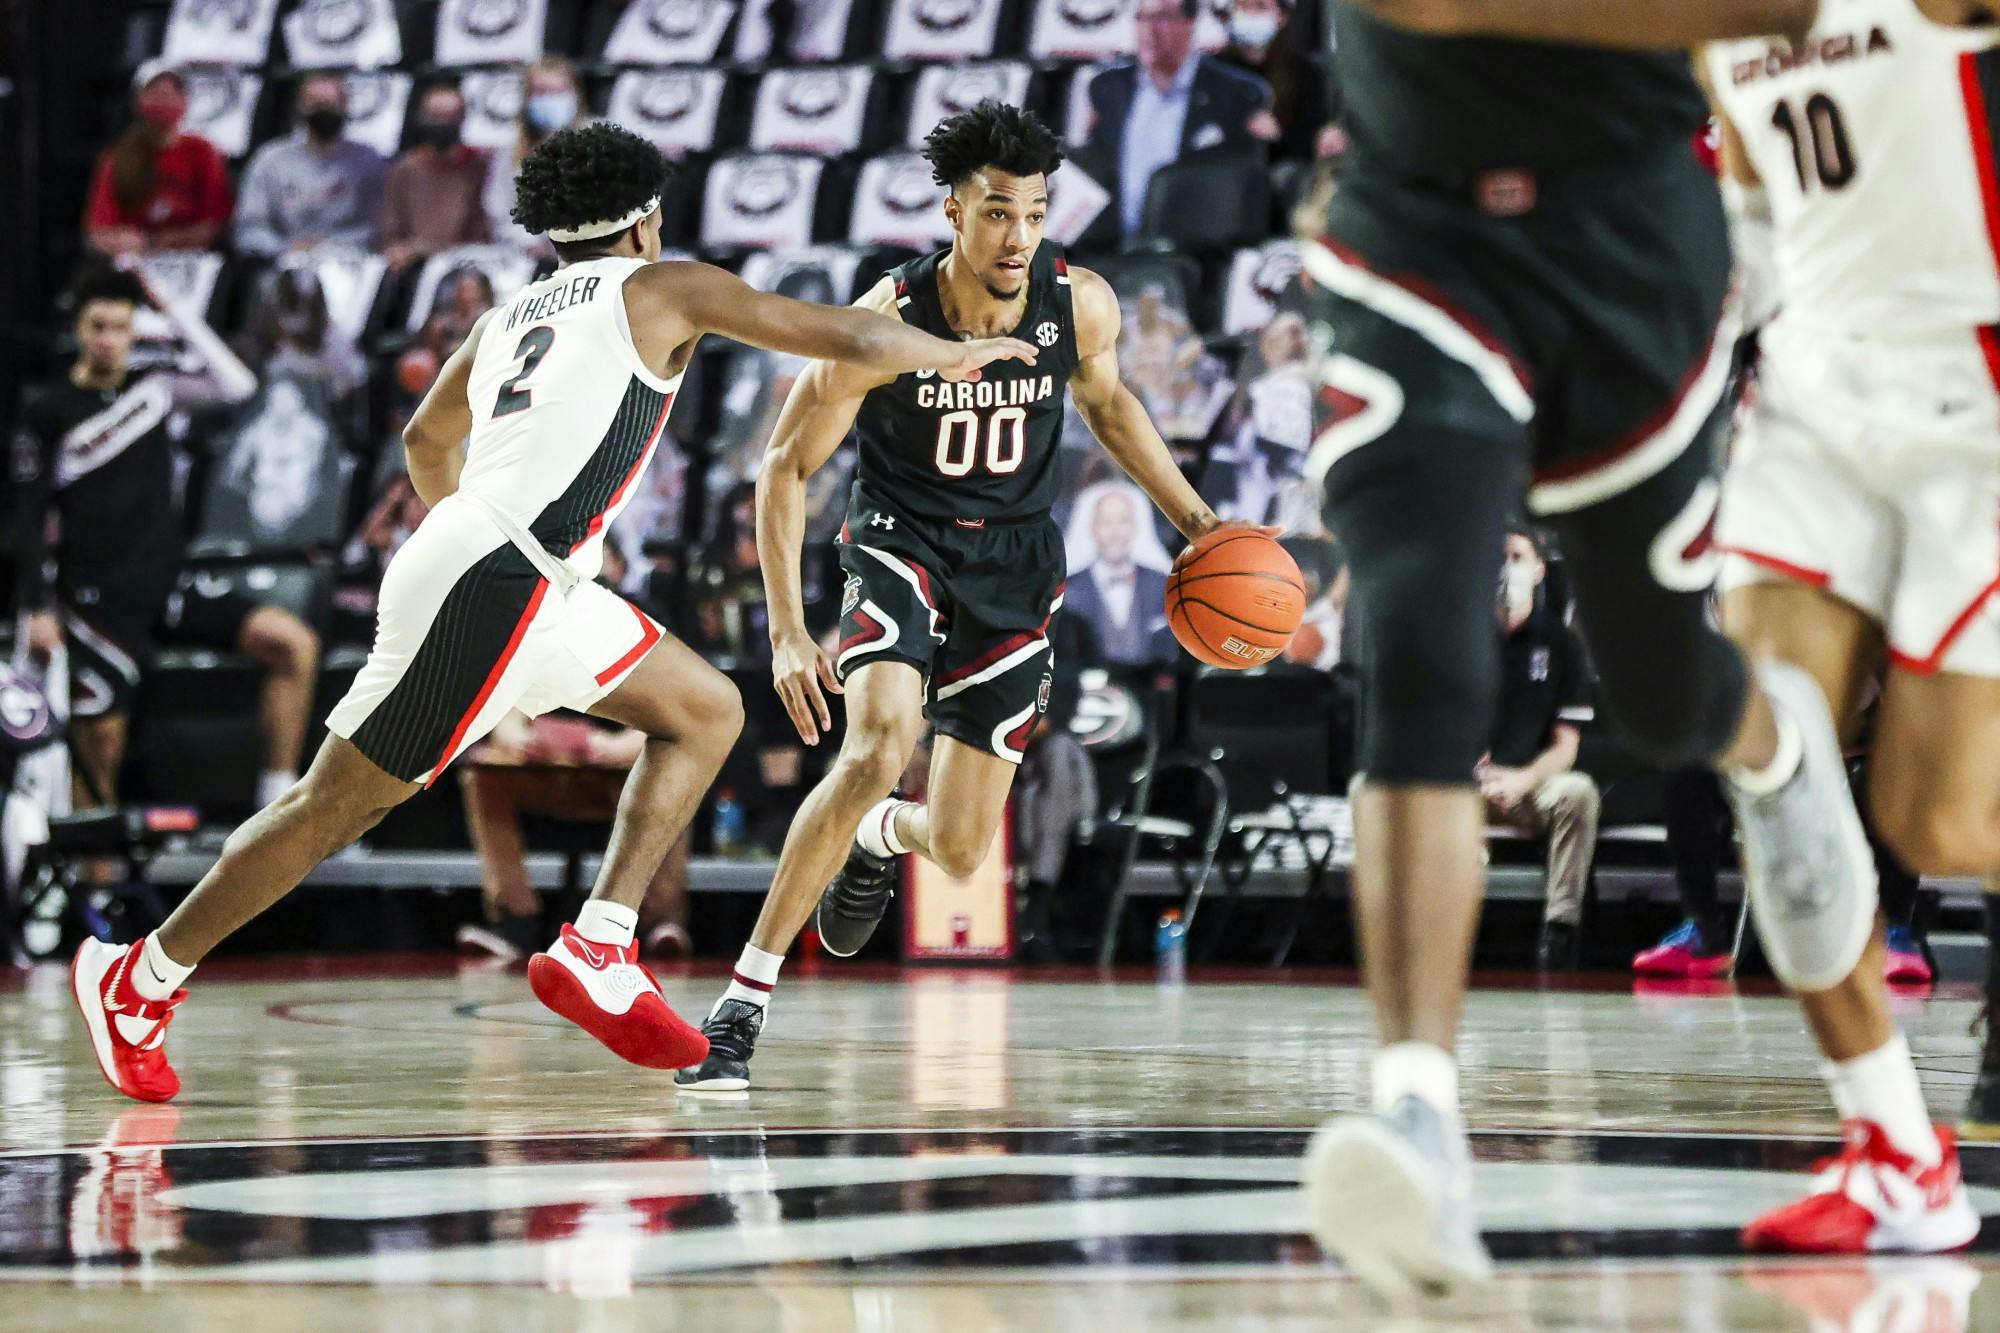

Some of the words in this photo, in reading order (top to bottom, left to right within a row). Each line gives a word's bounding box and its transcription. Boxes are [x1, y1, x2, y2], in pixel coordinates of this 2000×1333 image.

[1771, 93, 1857, 192] 10
[506, 276, 601, 332] WHEELER
[1035, 321, 1060, 347] SEC
[491, 324, 556, 419] 2
[917, 375, 1053, 409] CAROLINA
[934, 406, 1029, 478] 00
